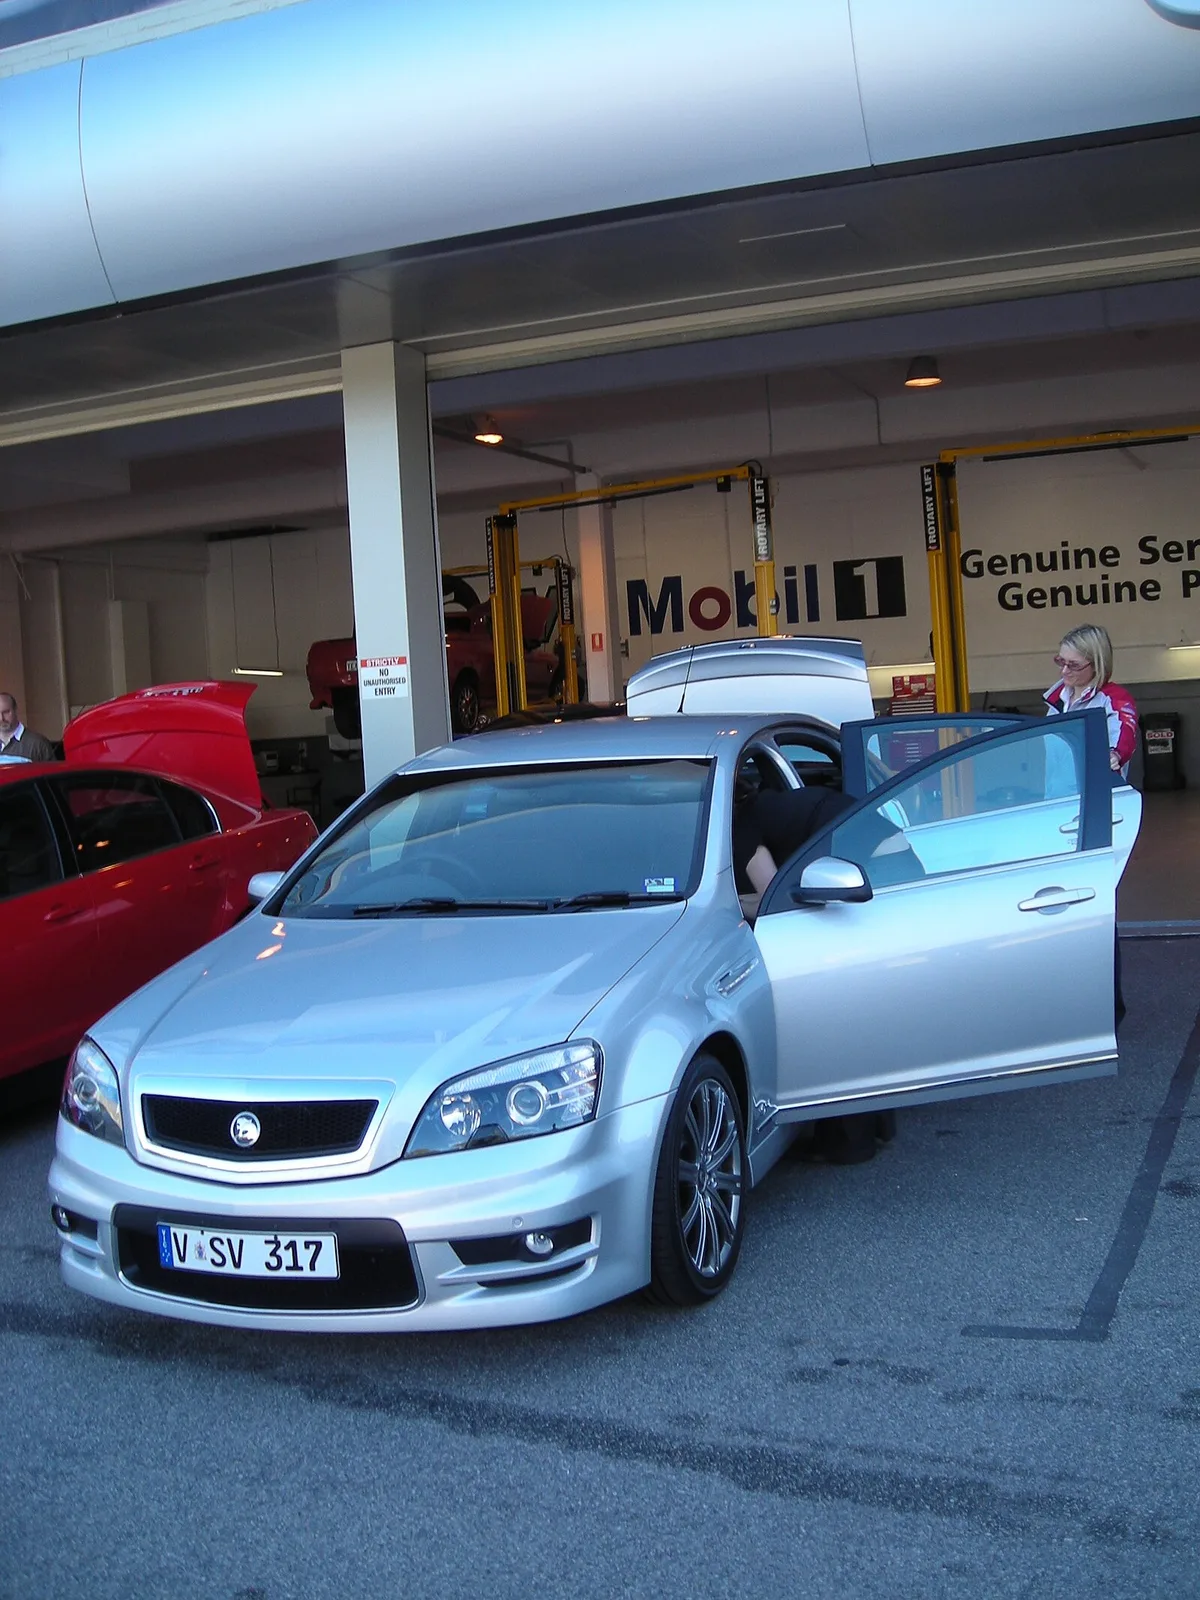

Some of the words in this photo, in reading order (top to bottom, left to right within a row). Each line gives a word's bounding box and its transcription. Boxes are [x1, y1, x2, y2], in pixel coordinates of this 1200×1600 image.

[754, 479, 765, 504] LIFT
[923, 467, 933, 493] LIFT
[755, 507, 768, 555] ROTARY
[924, 495, 937, 544] ROTARY
[960, 540, 1121, 579] Genuine
[561, 568, 569, 585] LIFT
[853, 561, 880, 617] 1
[562, 587, 571, 620] ROTARY
[997, 573, 1162, 611] Genuine
[366, 656, 400, 668] STRICTLY
[379, 668, 389, 677] NO
[363, 677, 406, 687] UNAUTHORISED
[374, 686, 396, 697] ENTRY
[264, 1239, 323, 1272] 317
